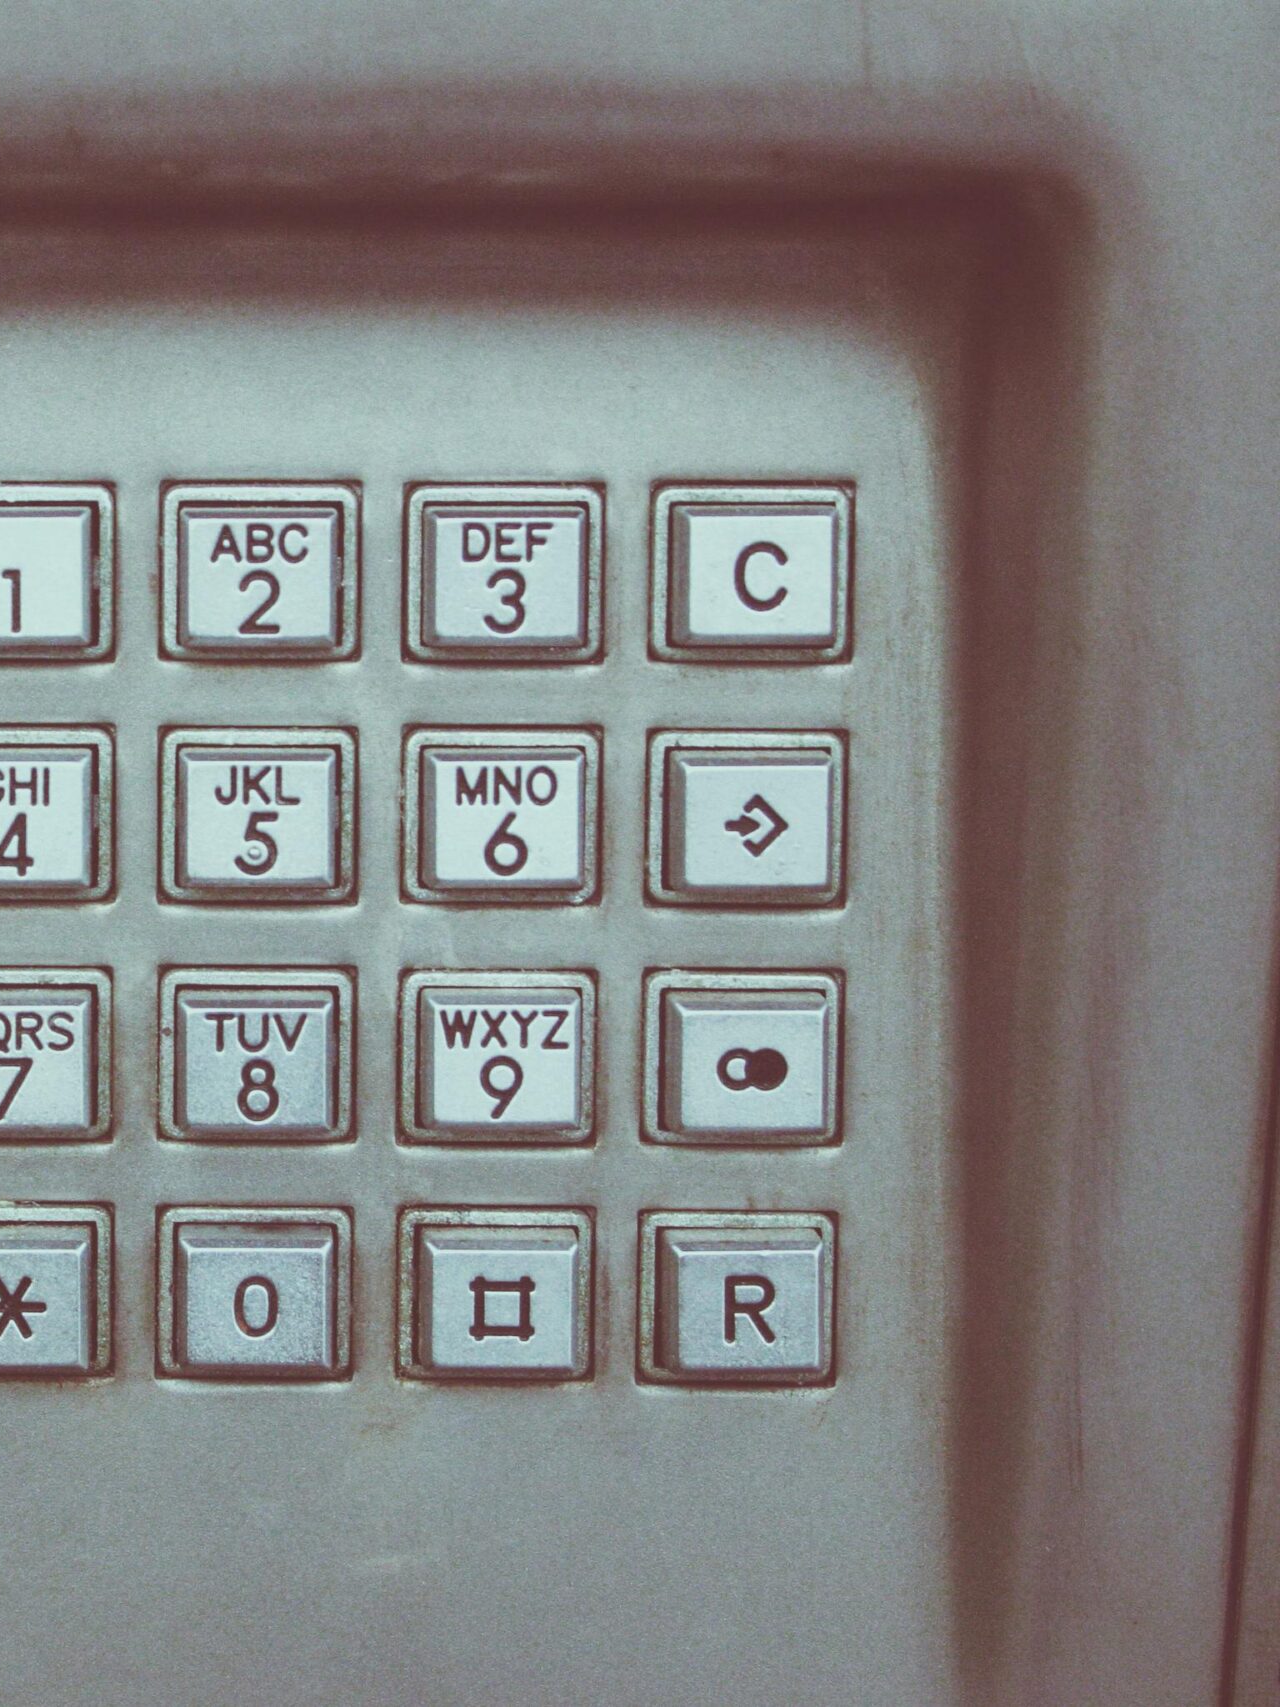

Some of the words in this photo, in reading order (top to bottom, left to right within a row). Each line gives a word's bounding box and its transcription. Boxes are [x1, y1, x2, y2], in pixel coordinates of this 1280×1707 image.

[211, 523, 308, 563] ABC
[462, 522, 554, 562] DEF
[1, 569, 22, 633] 1
[238, 569, 280, 634] 2
[484, 568, 526, 633] 3
[734, 541, 788, 611] C
[214, 765, 300, 805] JKL
[455, 765, 558, 806] MNO
[234, 811, 278, 875] 5
[484, 812, 528, 876] 6
[204, 1013, 308, 1052] TUV
[439, 1009, 570, 1049] WXYZ
[237, 1058, 279, 1121] 8
[479, 1057, 524, 1119] 9
[725, 1274, 776, 1343] R
